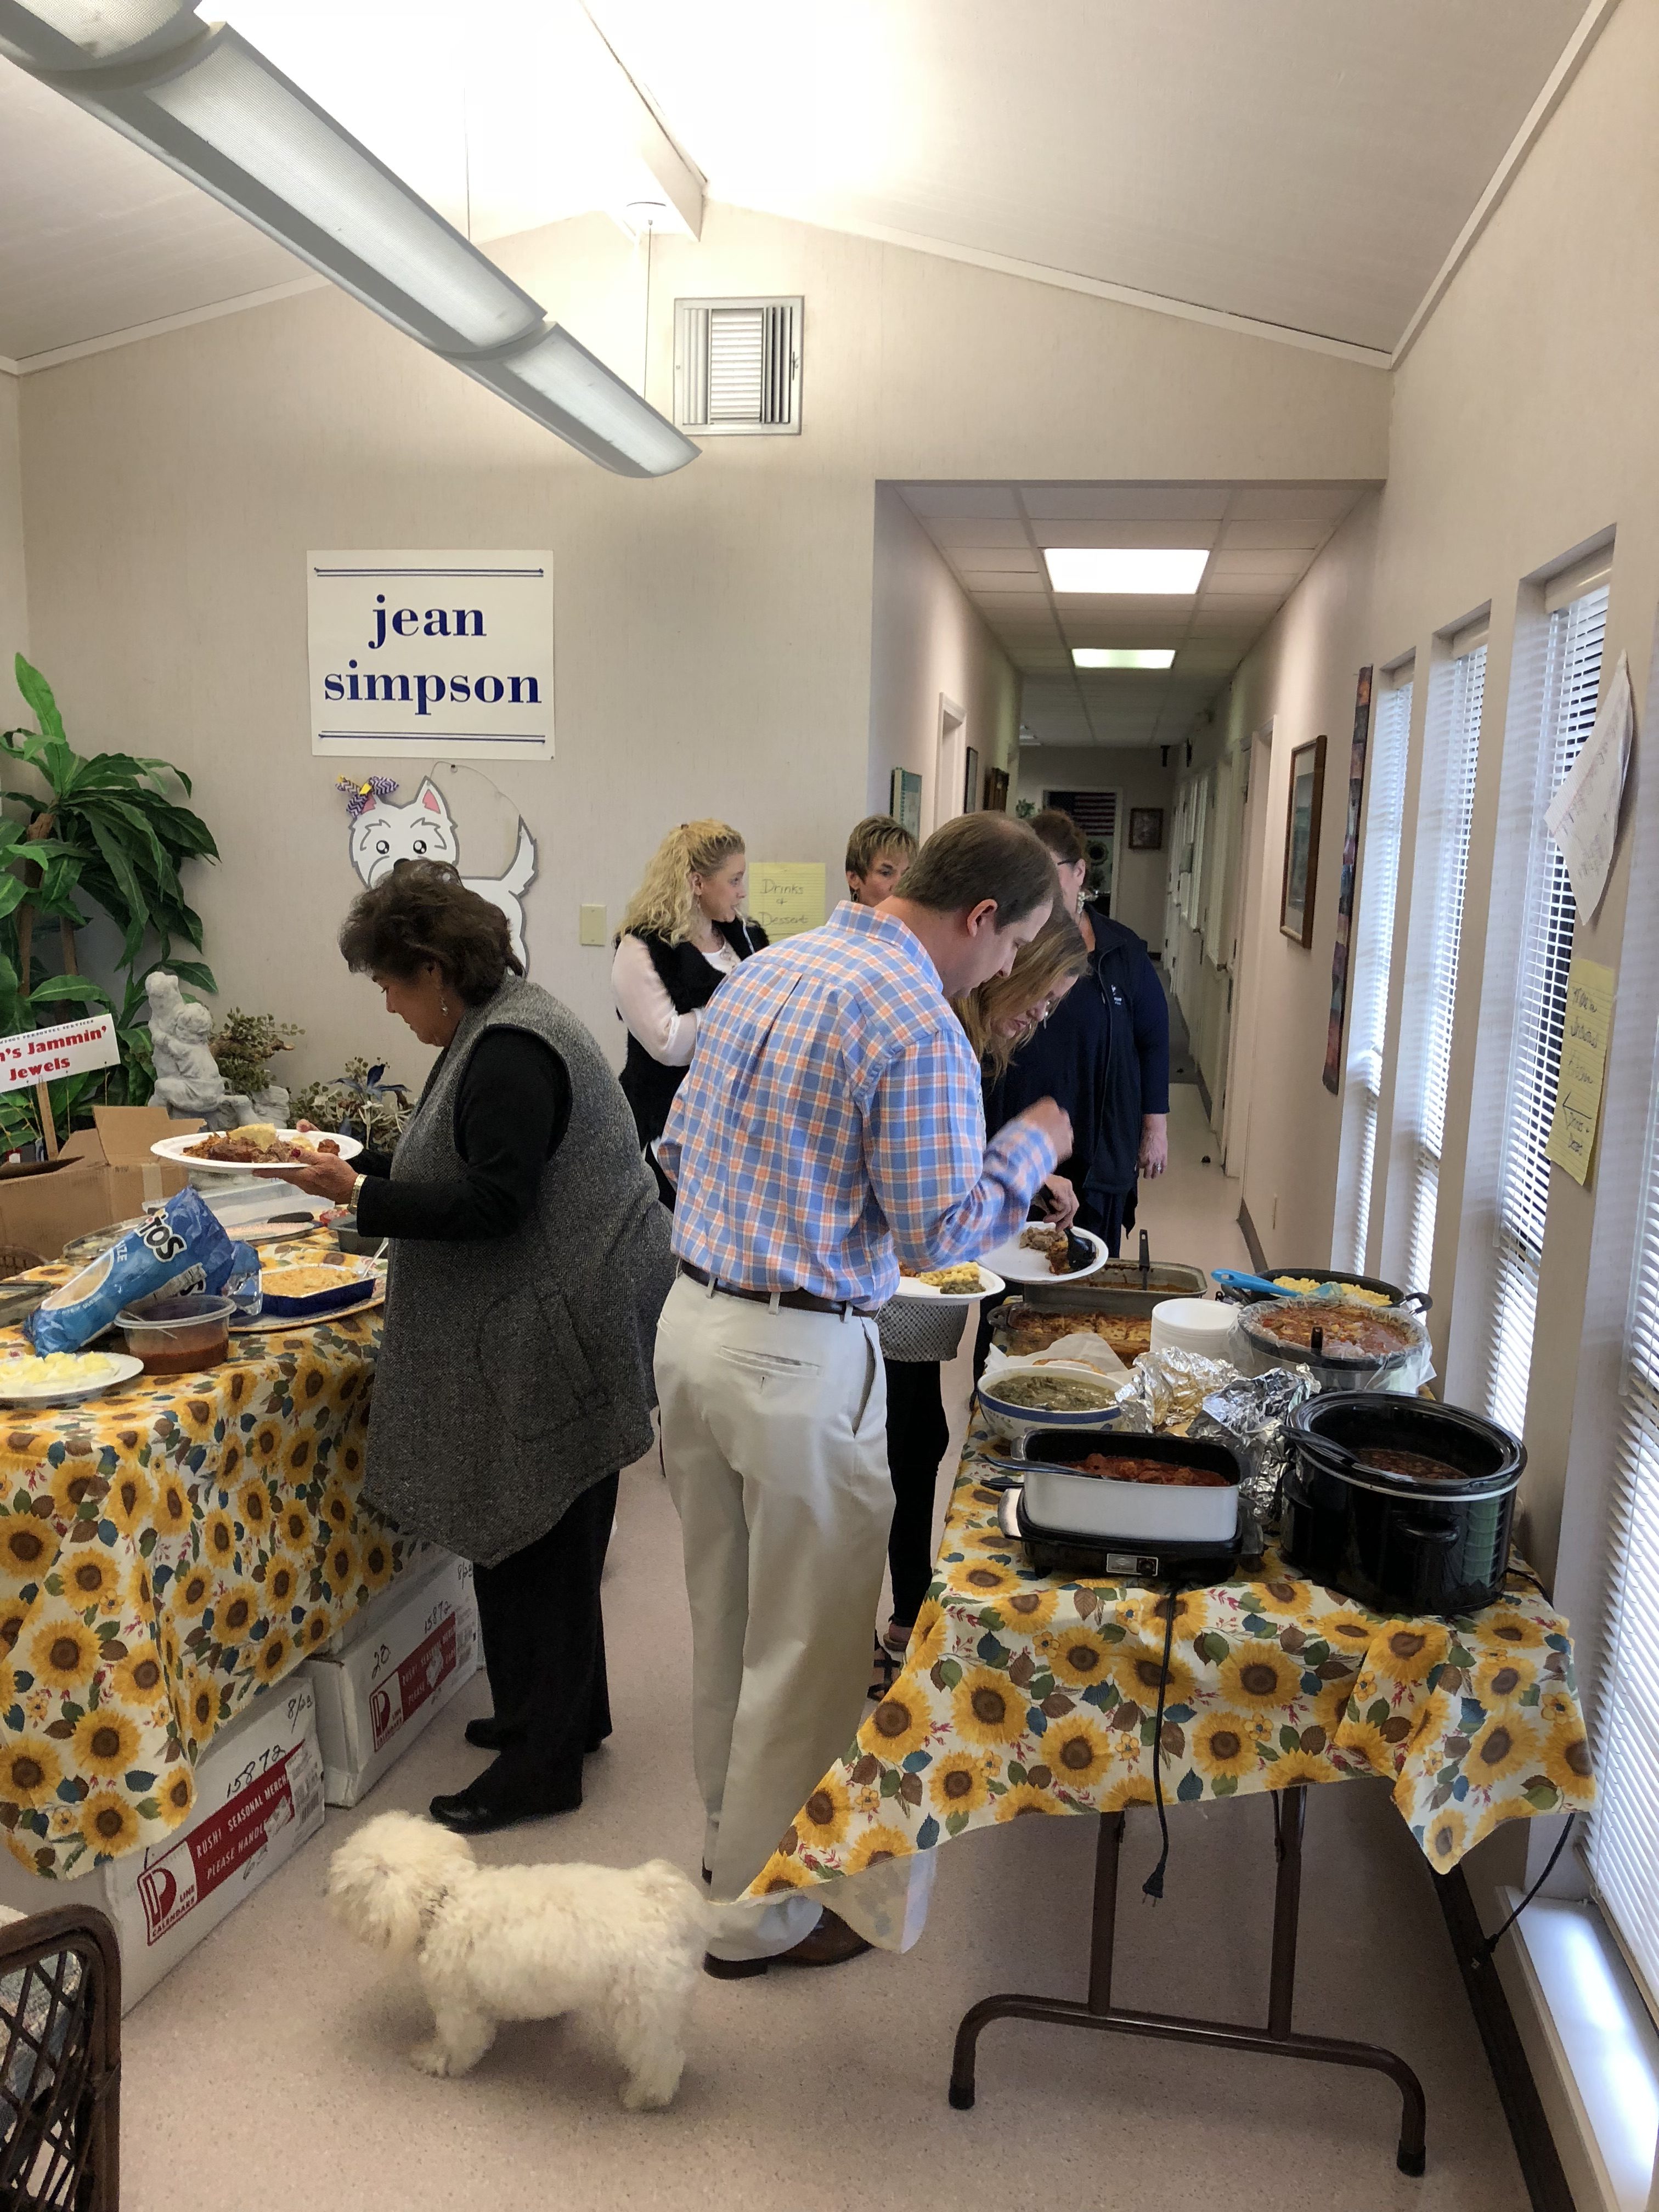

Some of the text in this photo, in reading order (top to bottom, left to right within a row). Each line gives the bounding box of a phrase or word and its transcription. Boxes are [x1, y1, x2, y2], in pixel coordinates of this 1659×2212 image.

[368, 594, 487, 649] jean
[324, 659, 542, 715] simpson
[760, 878, 804, 895] Drinks
[27, 1025, 107, 1055] Jammin'
[9, 1058, 71, 1081] Jewels
[227, 1795, 264, 1832] SEASONAL
[264, 1773, 289, 1801] MERCH
[206, 1846, 235, 1881] PLEASE
[238, 1821, 265, 1854] HANDL
